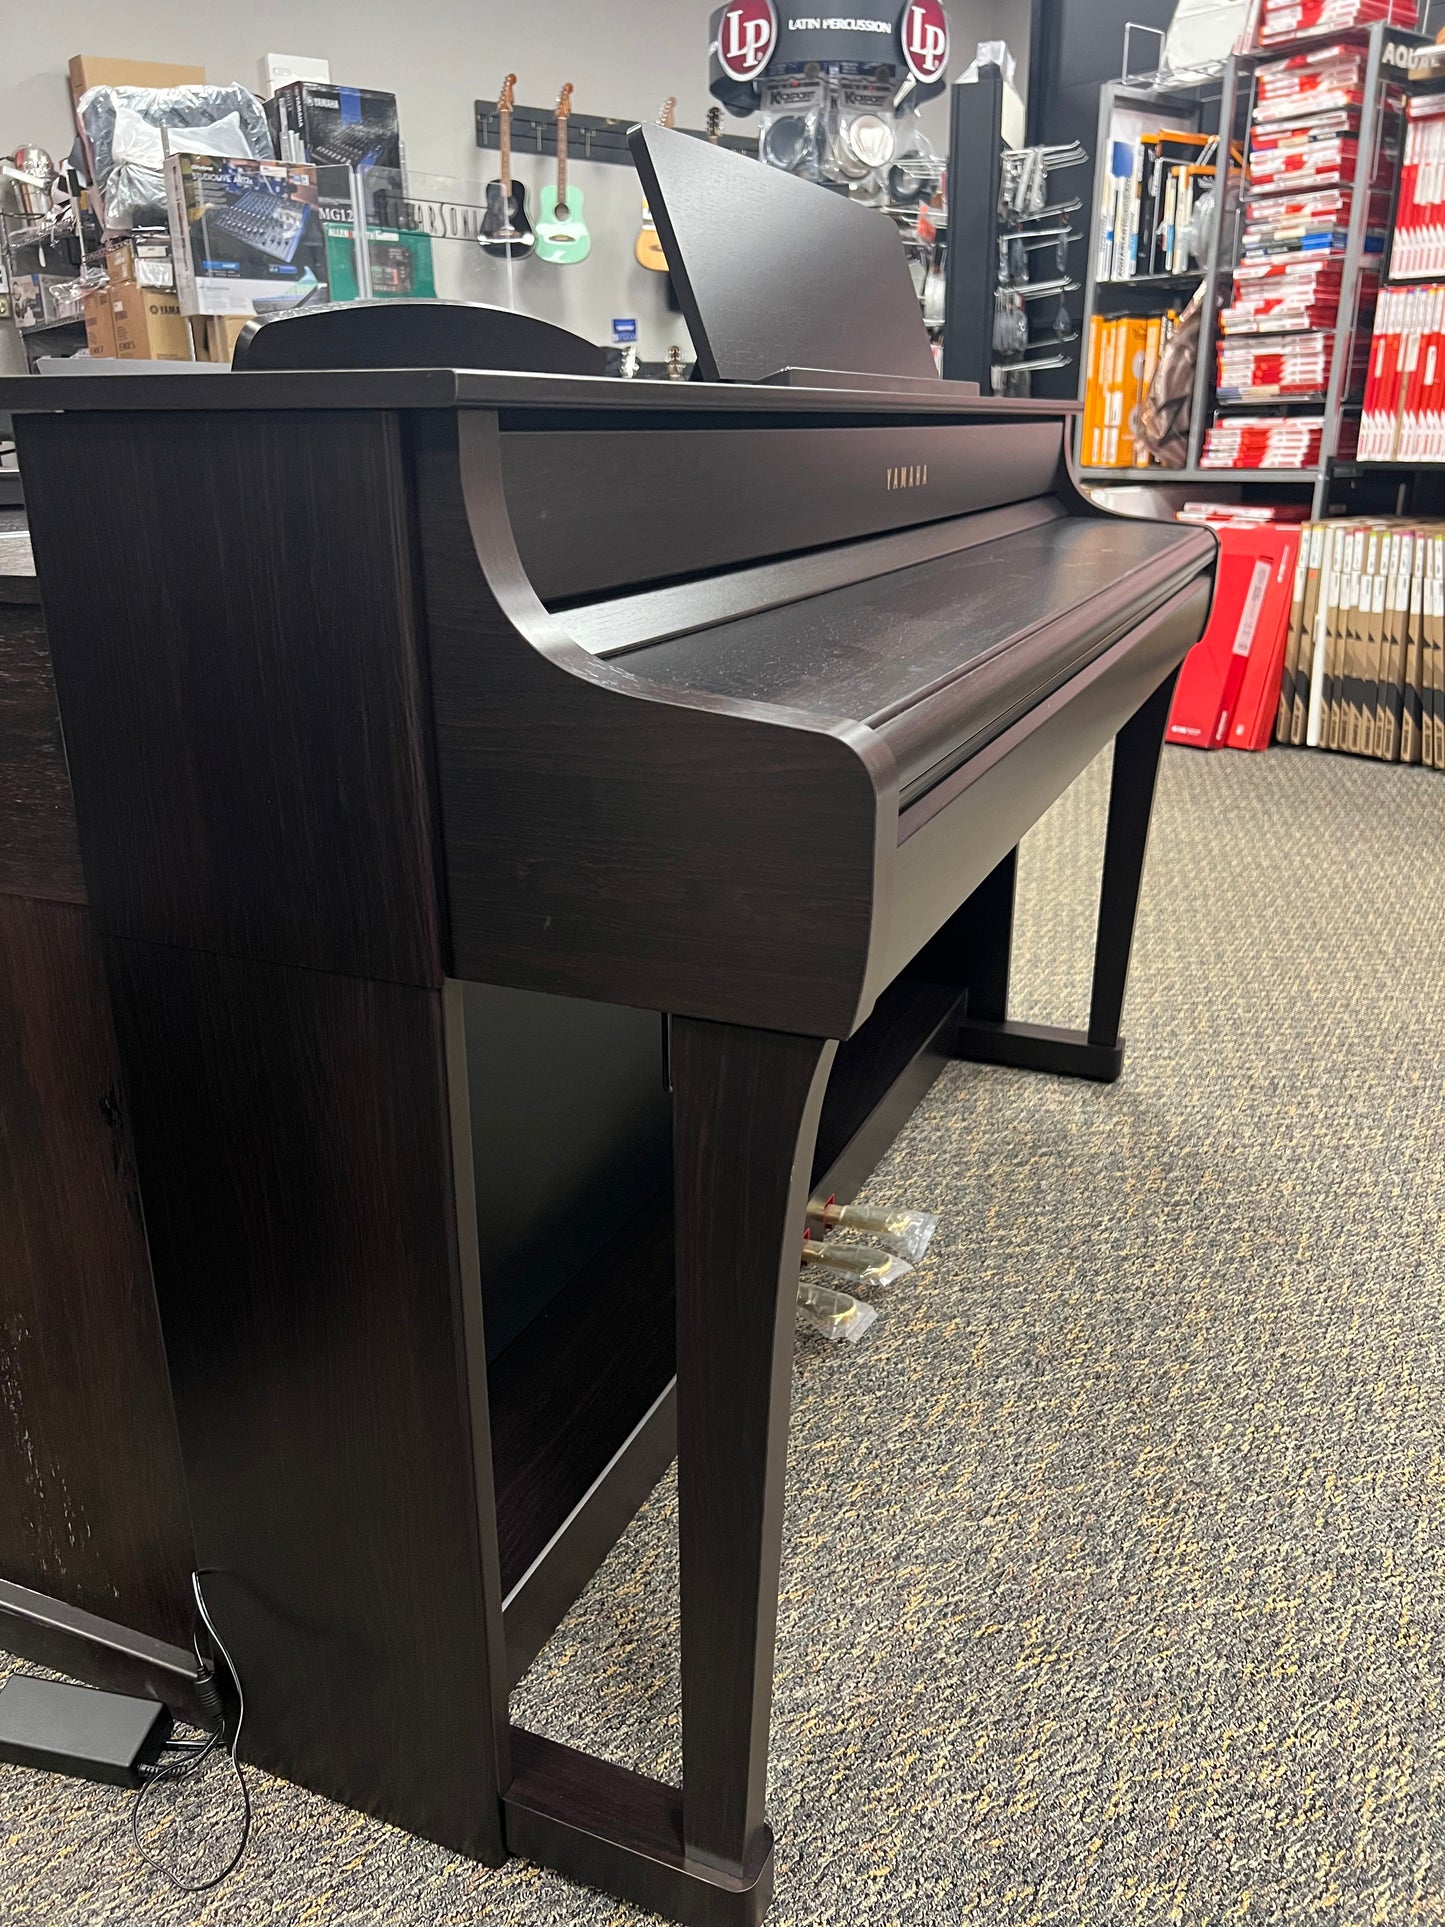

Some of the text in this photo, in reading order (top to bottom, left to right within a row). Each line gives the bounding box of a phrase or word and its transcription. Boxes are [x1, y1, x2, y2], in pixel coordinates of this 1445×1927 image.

[727, 10, 770, 67] LP
[788, 18, 892, 34] LATIN PERCUSSION
[910, 6, 945, 71] LP
[318, 207, 354, 222] MG12
[886, 464, 928, 491] YAMAHA
